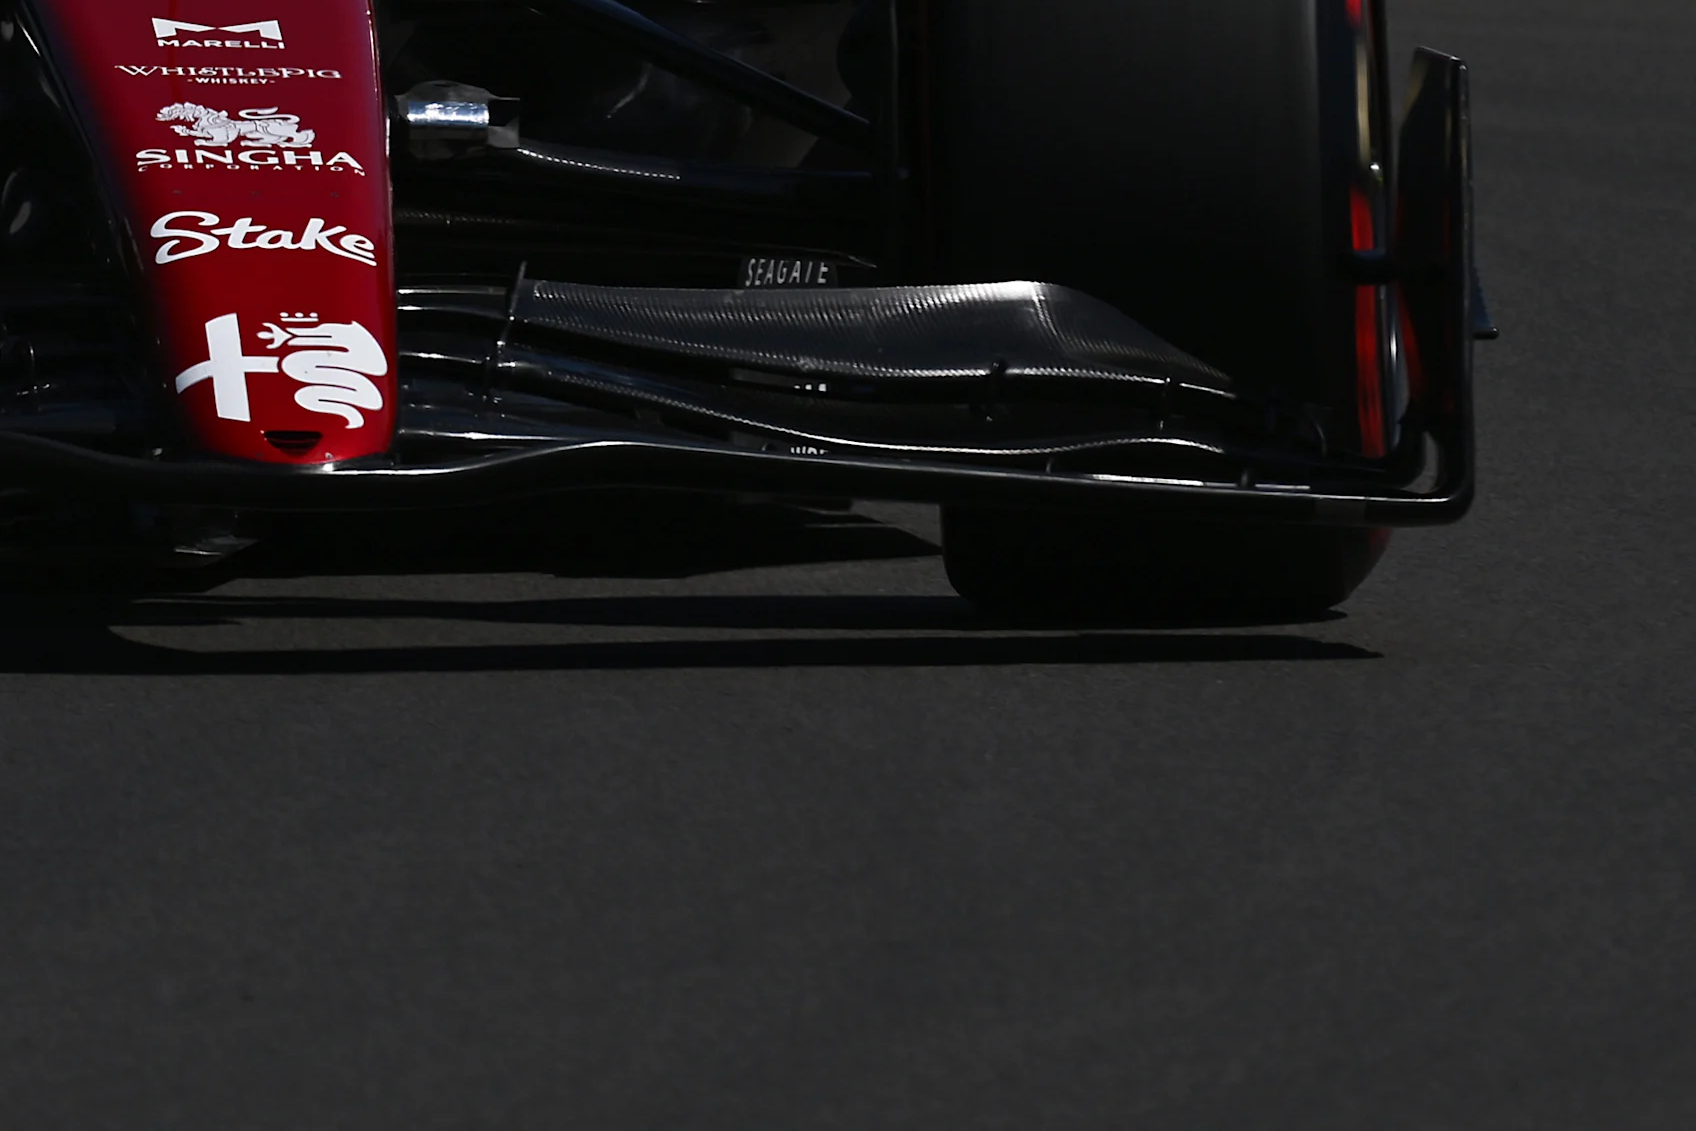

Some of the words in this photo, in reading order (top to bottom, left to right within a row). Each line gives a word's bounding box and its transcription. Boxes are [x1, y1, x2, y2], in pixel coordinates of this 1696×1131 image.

[157, 38, 286, 50] MARELLI
[135, 148, 364, 171] SINGHA
[137, 163, 366, 177] CORPORATION
[149, 210, 377, 267] Stake
